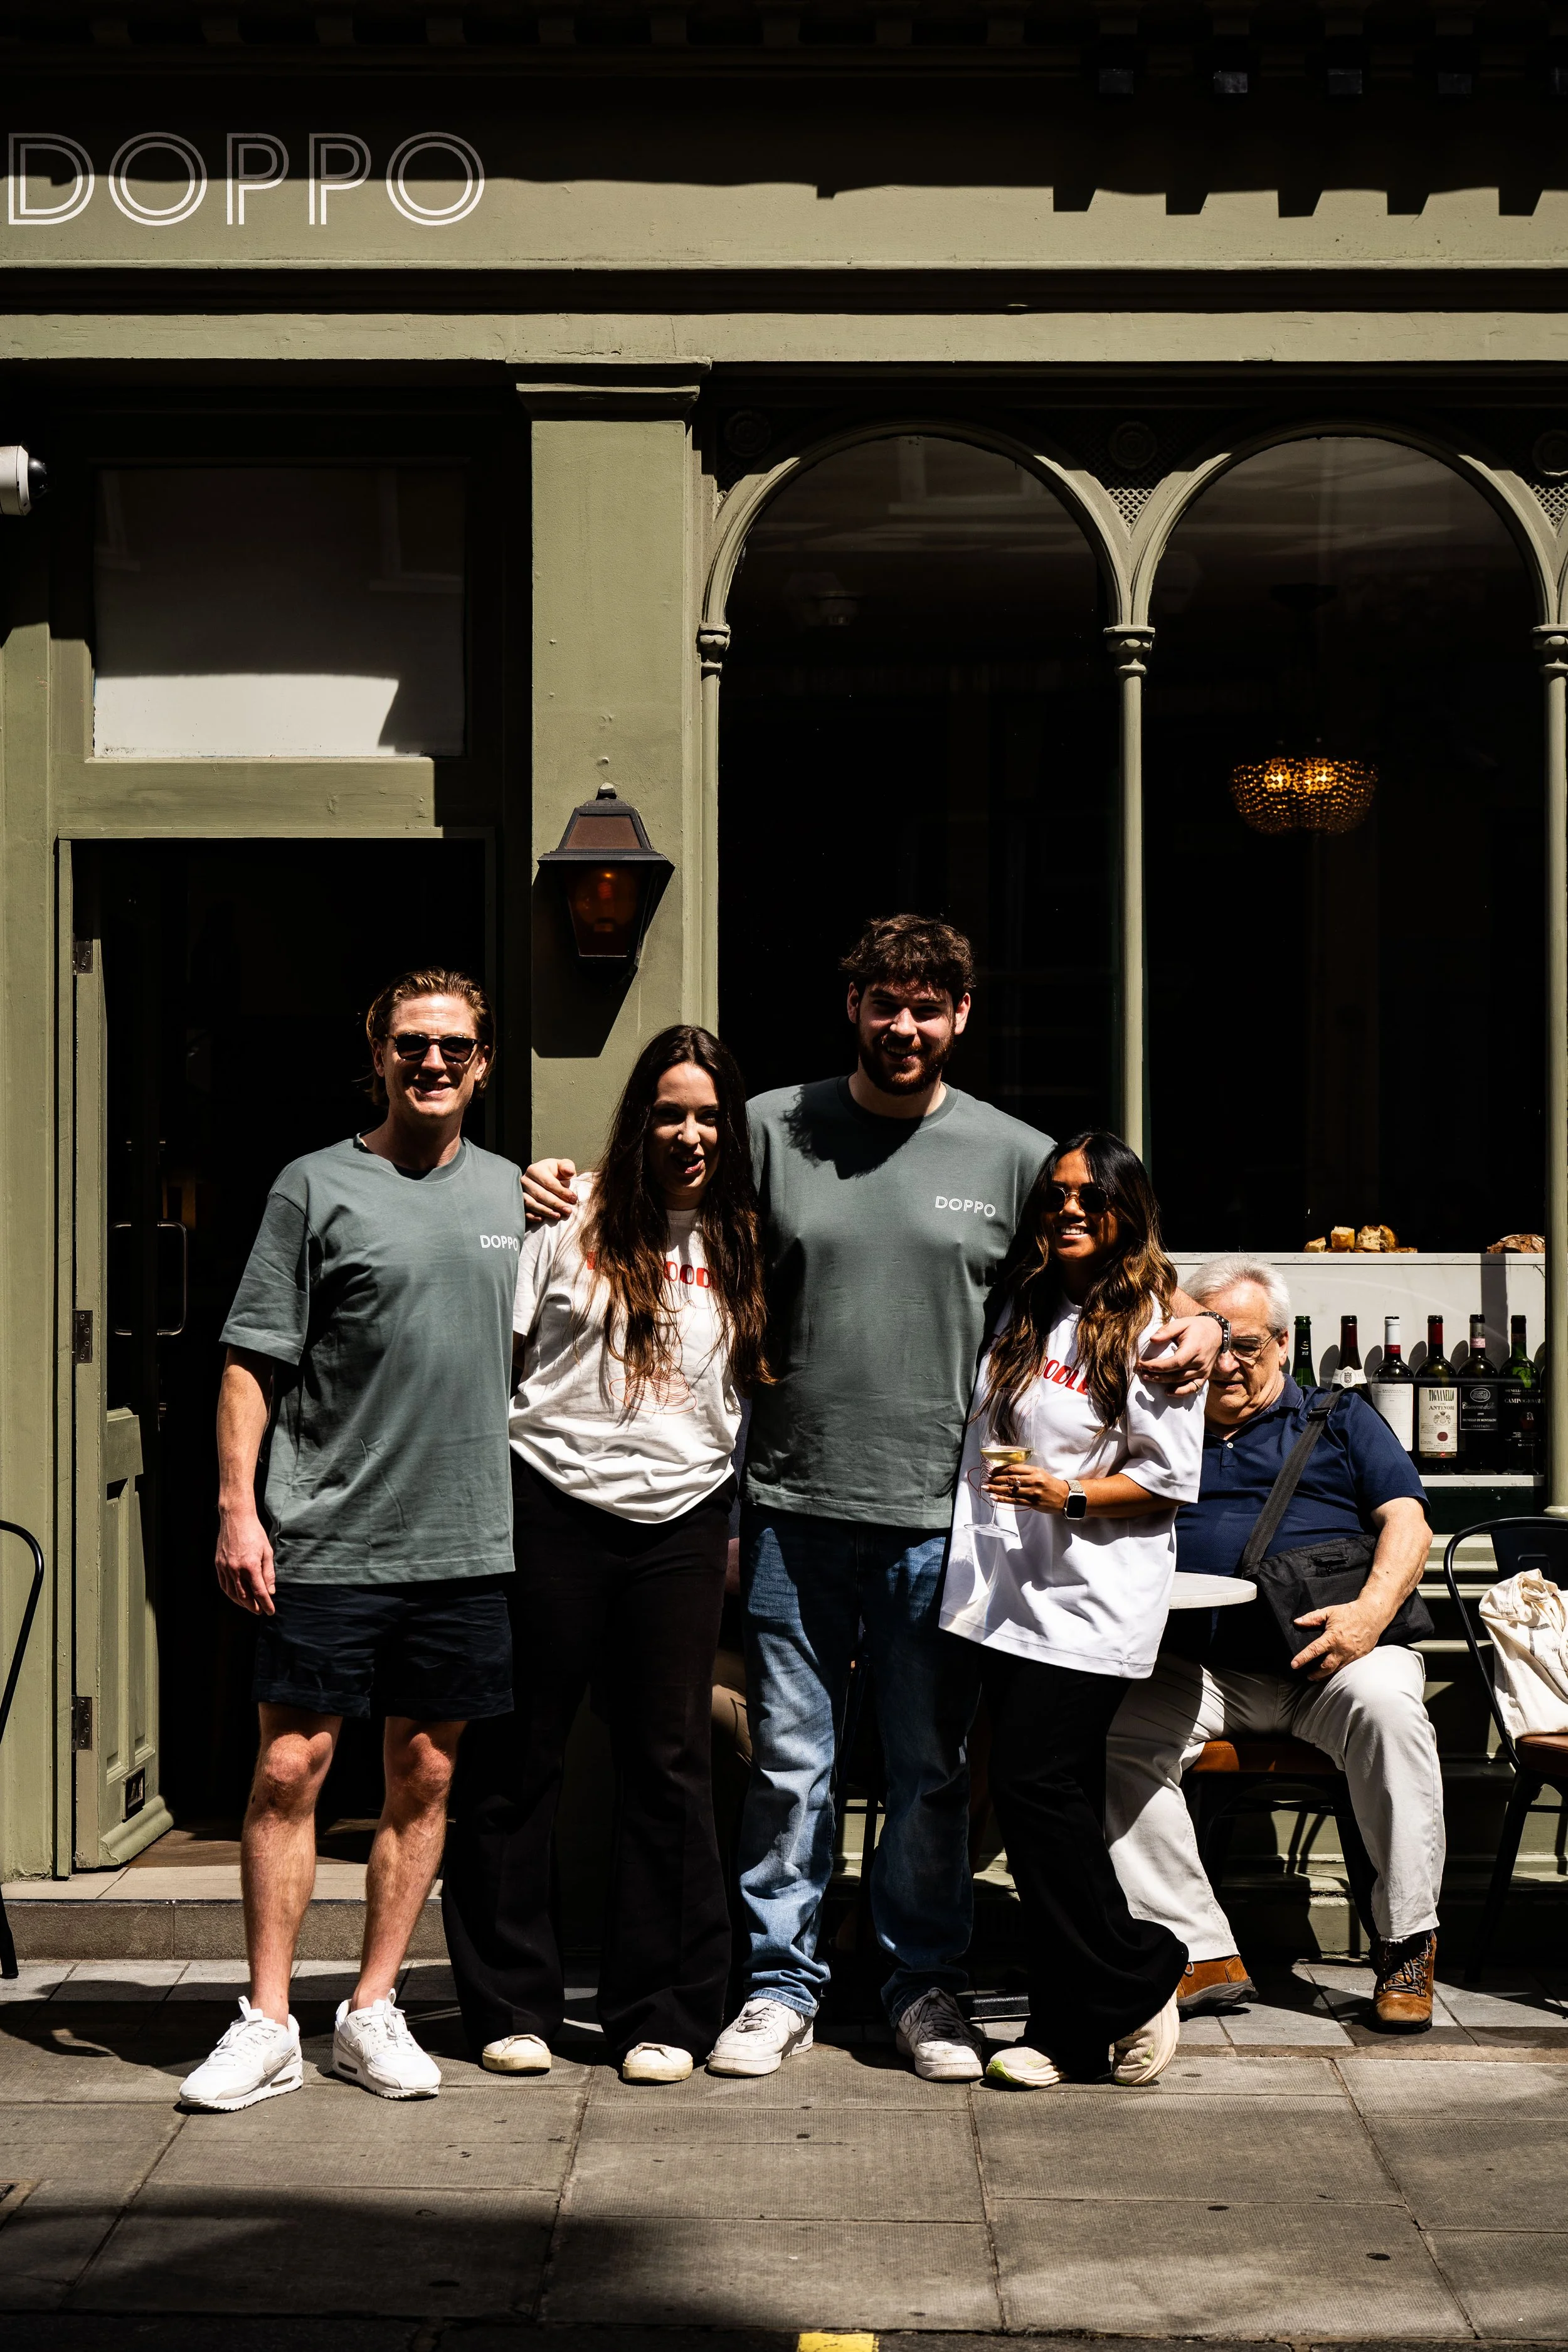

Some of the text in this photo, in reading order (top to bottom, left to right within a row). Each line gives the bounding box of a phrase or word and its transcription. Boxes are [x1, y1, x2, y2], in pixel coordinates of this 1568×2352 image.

[8, 132, 485, 226] DOPPO
[935, 1195, 996, 1217] DOPPO
[480, 1234, 518, 1251] DOPPO
[664, 1261, 712, 1288] OOD
[1428, 1389, 1454, 1402] TIGNANELLO
